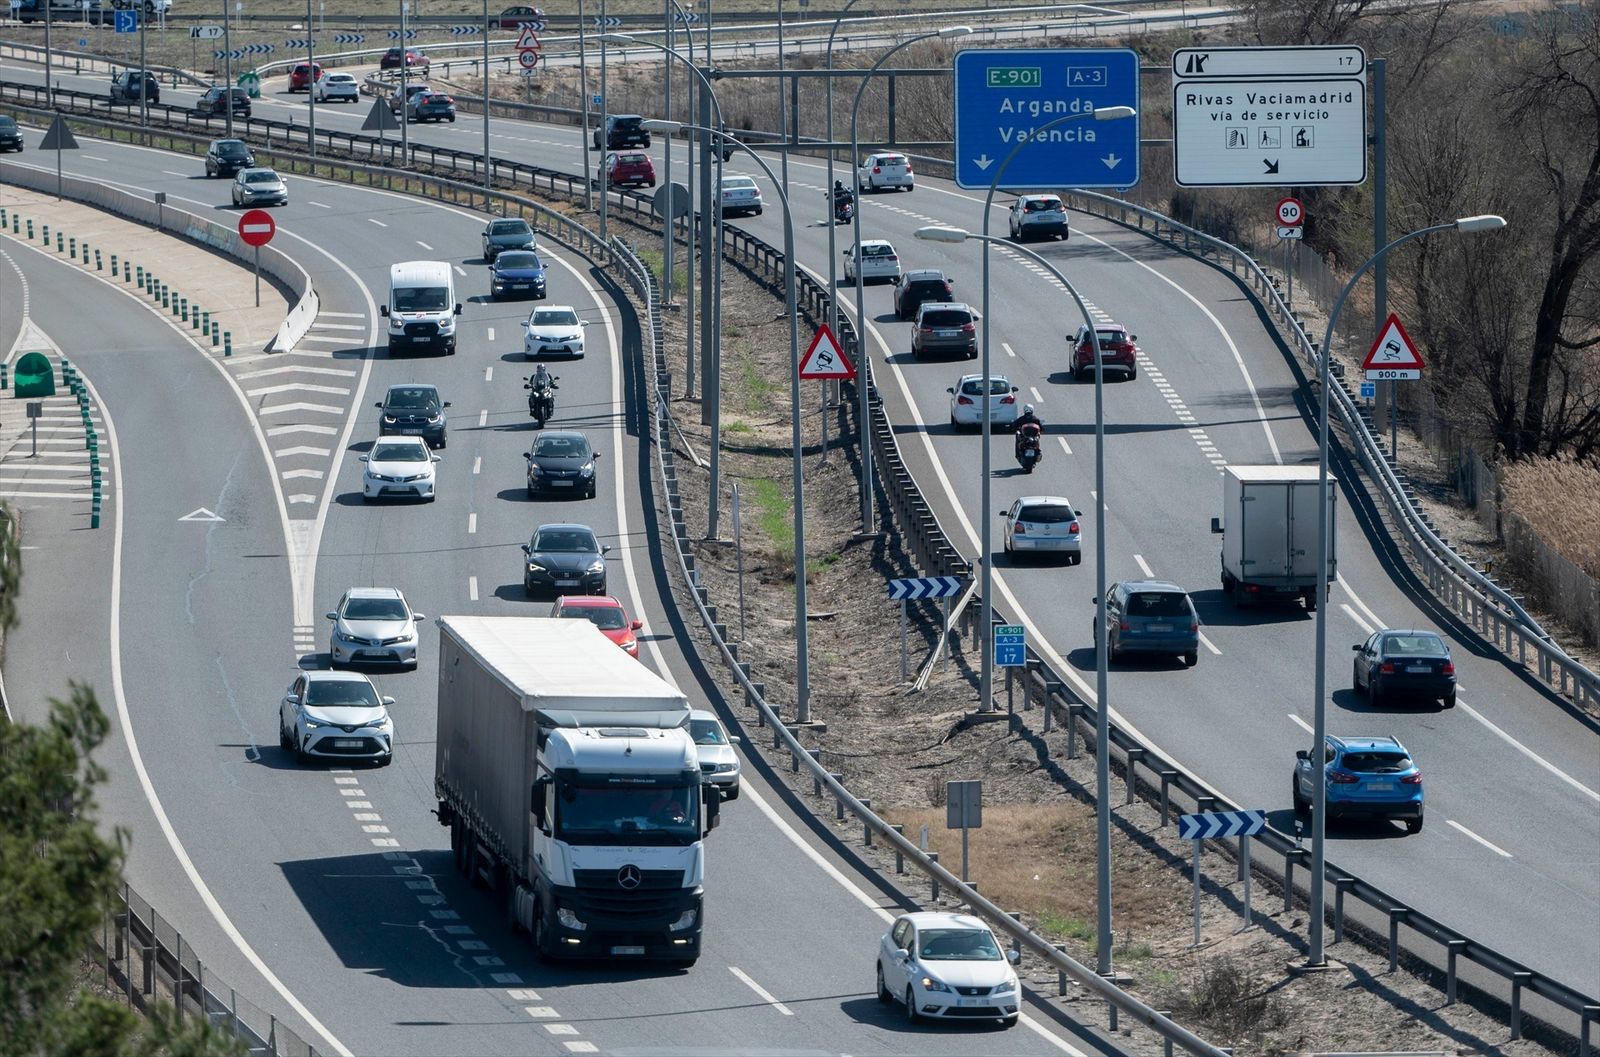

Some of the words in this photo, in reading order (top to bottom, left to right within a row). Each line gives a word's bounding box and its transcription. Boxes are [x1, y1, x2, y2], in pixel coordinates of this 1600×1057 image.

[208, 28, 218, 36] 17
[1339, 57, 1353, 65] 17
[990, 71, 1038, 83] E-901
[1073, 71, 1101, 82] A-3
[1186, 94, 1233, 106] Rivas
[1246, 92, 1352, 105] Vaciamadrid
[1000, 98, 1094, 117] Arganda
[1210, 111, 1232, 121] vía
[1241, 110, 1257, 121] de
[1267, 109, 1329, 121] servicio
[999, 127, 1096, 143] Valencia
[1282, 208, 1298, 217] 90
[1378, 371, 1397, 379] 900
[1003, 653, 1017, 663] 17
